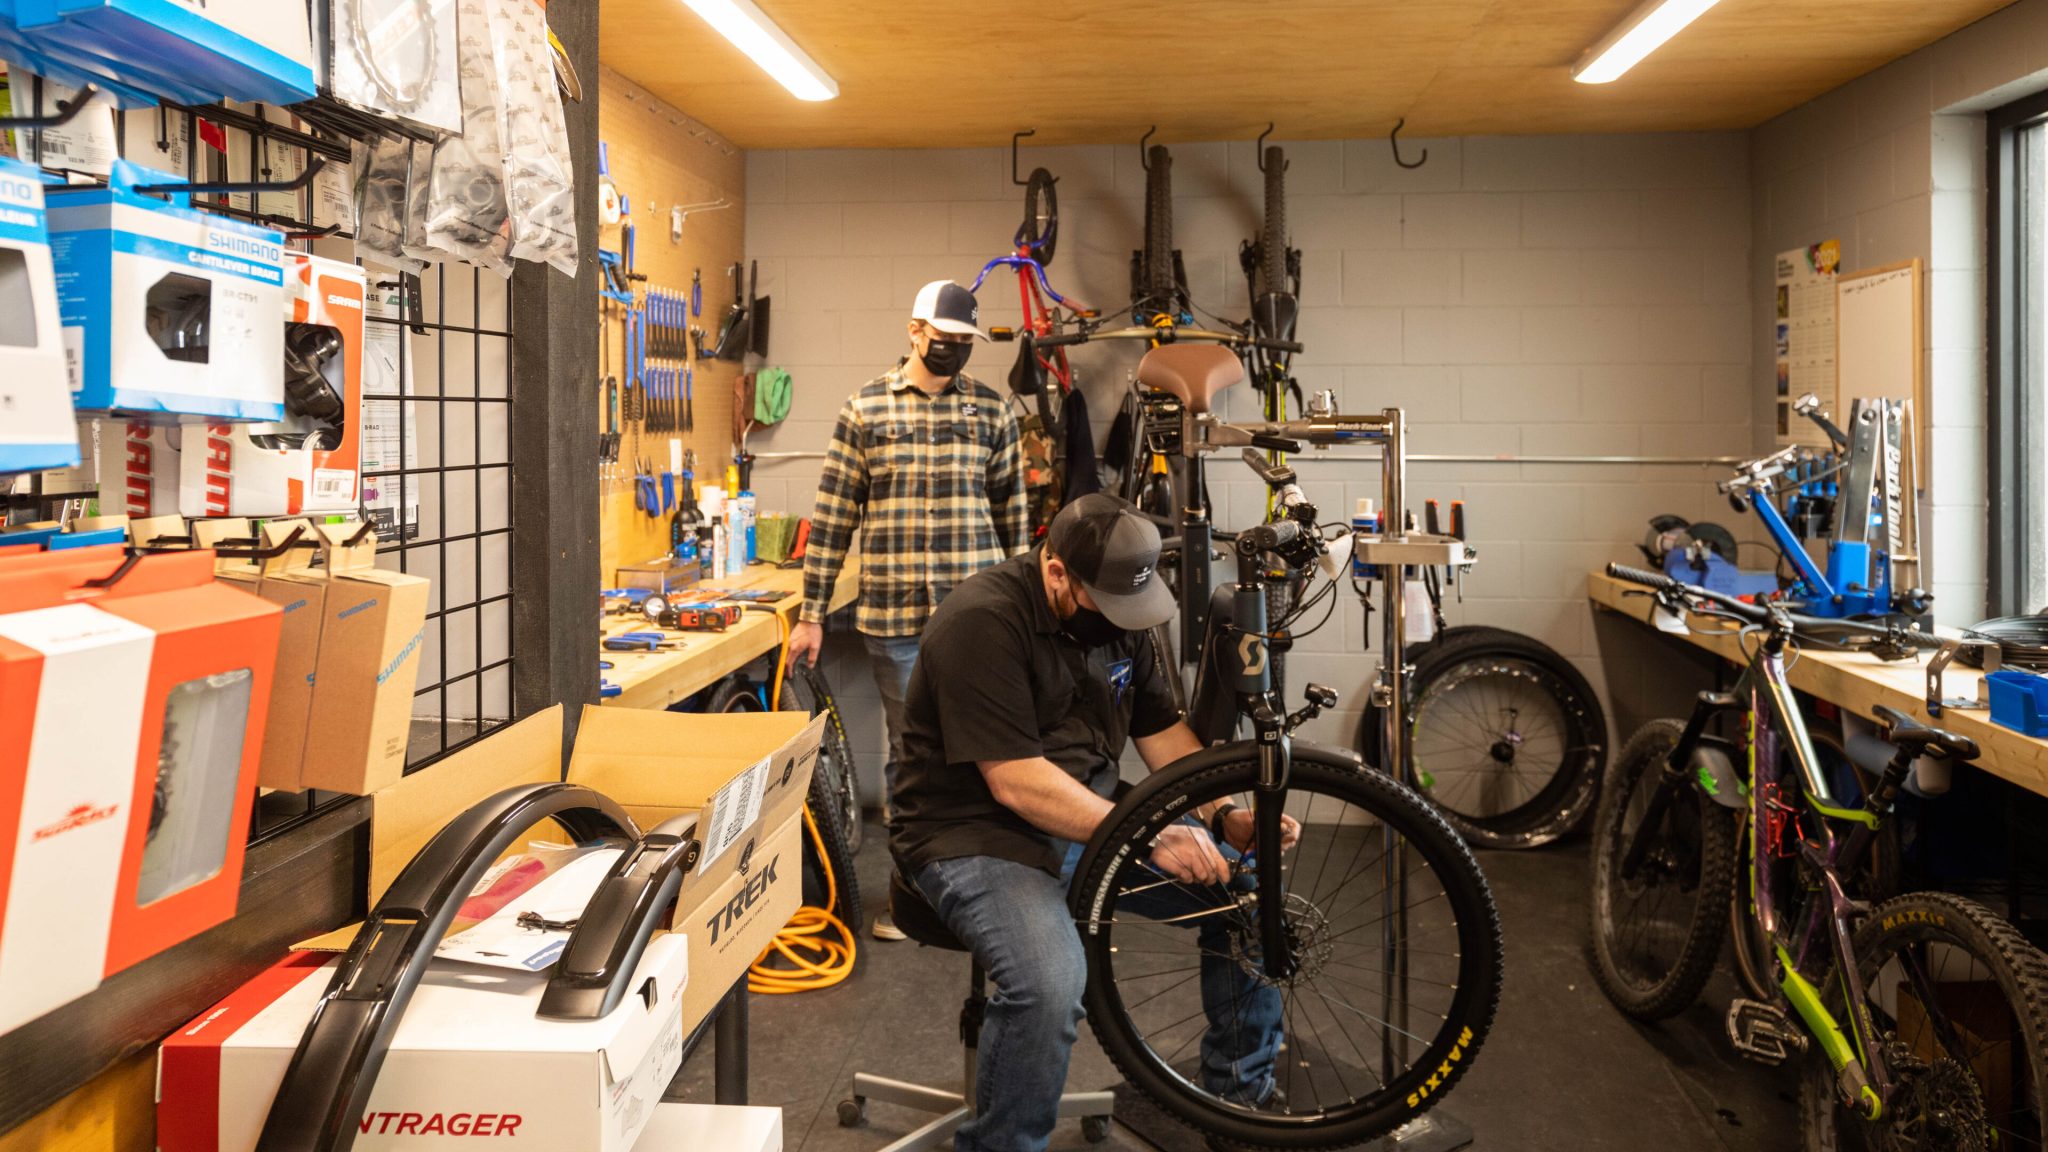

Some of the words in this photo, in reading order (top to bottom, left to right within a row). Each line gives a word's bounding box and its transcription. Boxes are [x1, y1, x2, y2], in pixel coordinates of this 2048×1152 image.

[209, 232, 279, 262] SHIMANO
[188, 251, 250, 275] CANTILEVER
[251, 265, 280, 282] BRAKE
[328, 294, 361, 310] SRAM
[366, 294, 380, 302] ASE
[127, 422, 153, 518] RAM
[206, 423, 233, 517] RAM
[337, 599, 378, 620] SHIMANO
[706, 852, 780, 947] TREK
[1882, 911, 1945, 931] MAXXIS
[1407, 1025, 1474, 1108] MAXXIS
[359, 1112, 522, 1137] NTRAGER
